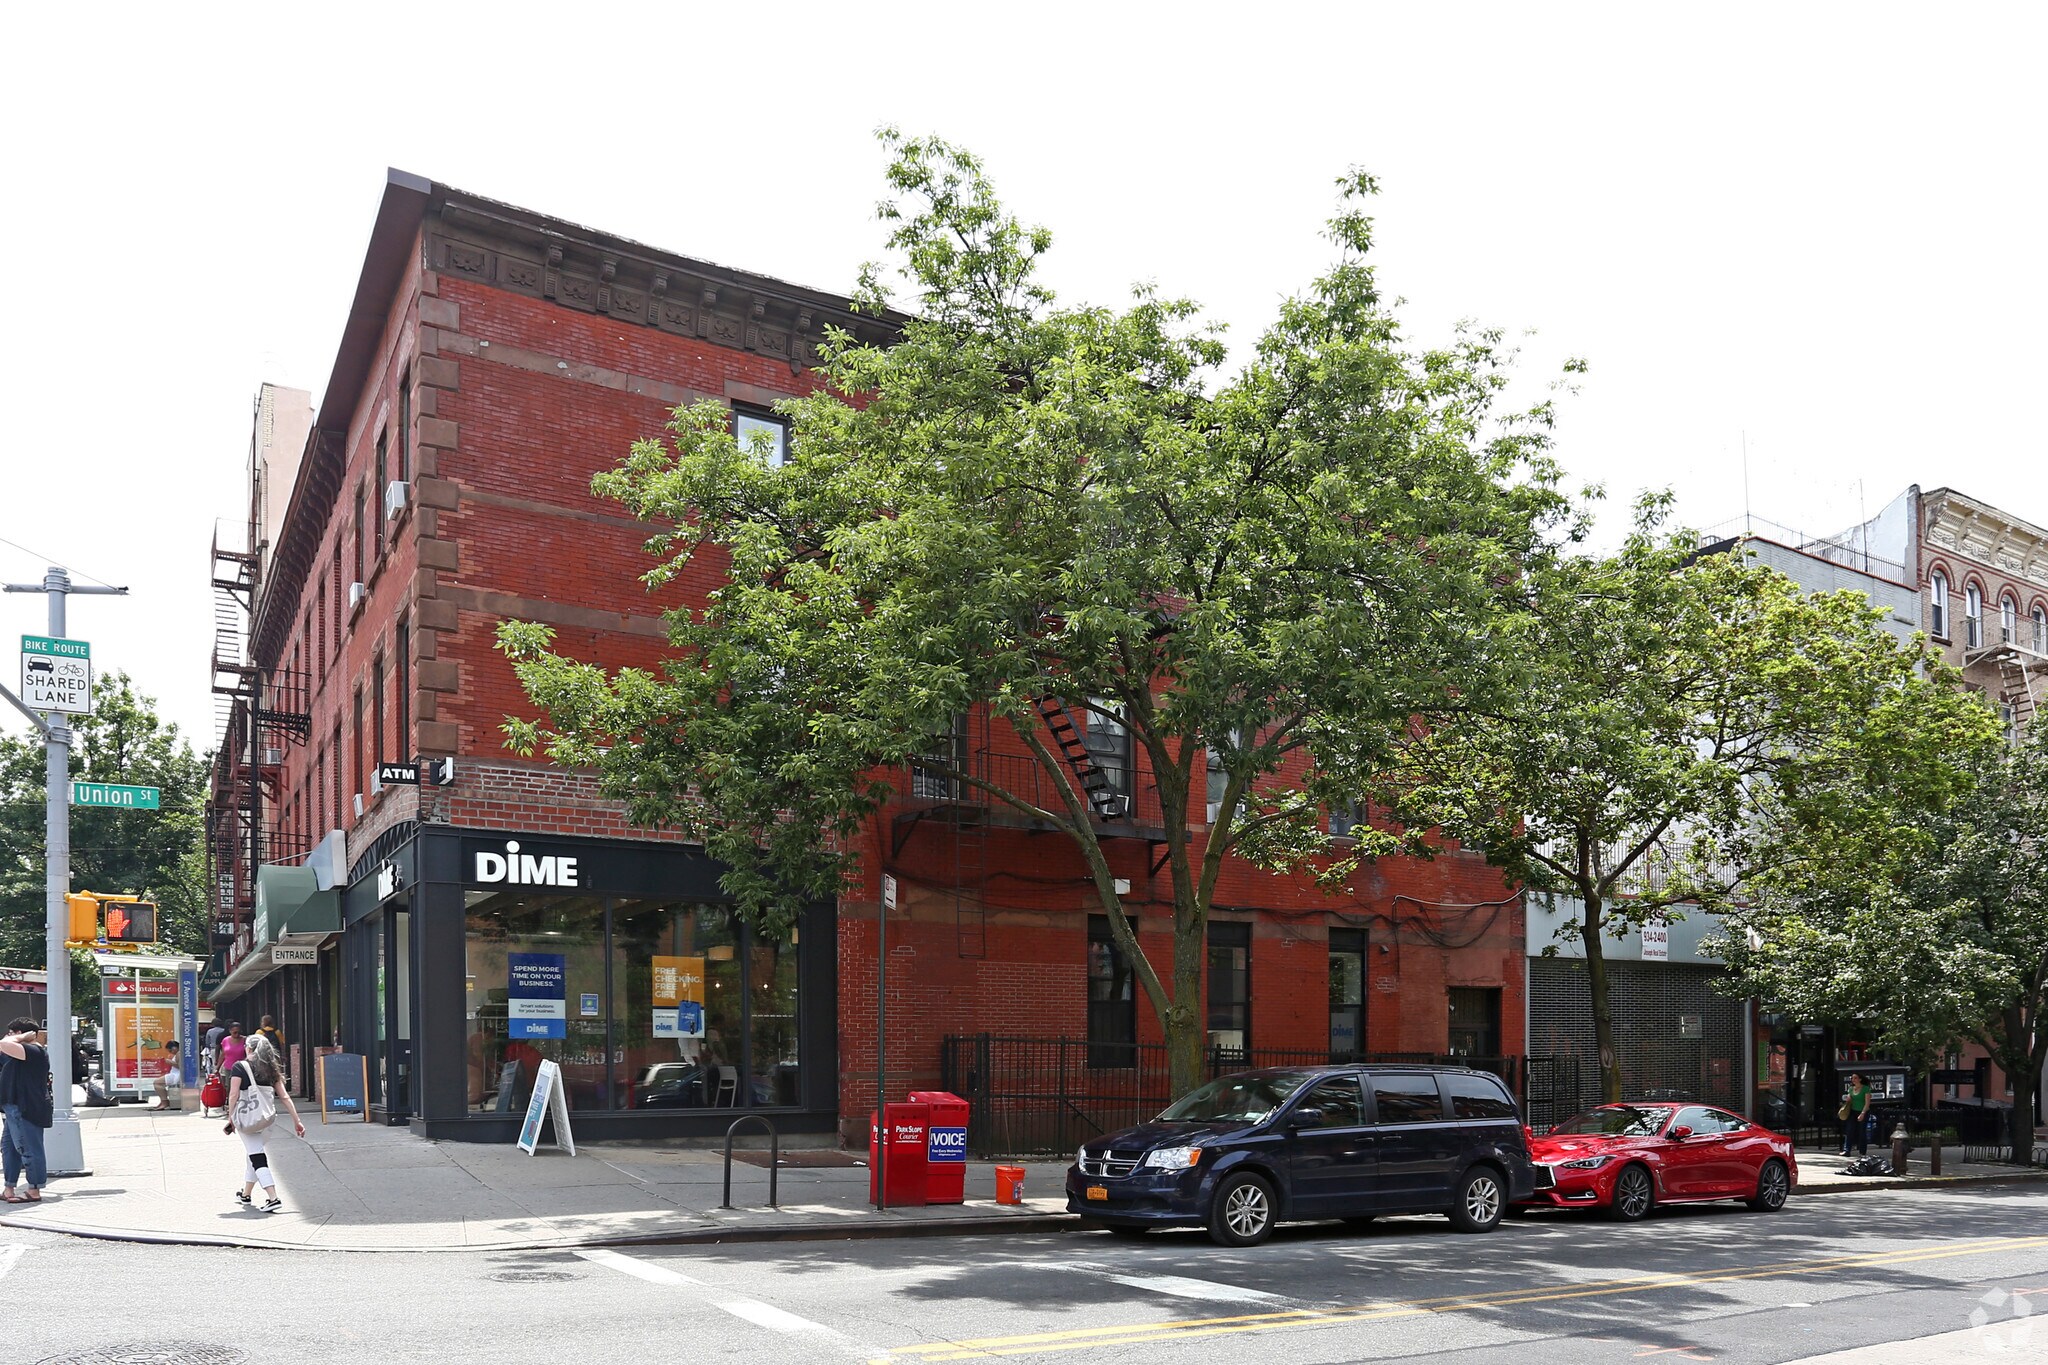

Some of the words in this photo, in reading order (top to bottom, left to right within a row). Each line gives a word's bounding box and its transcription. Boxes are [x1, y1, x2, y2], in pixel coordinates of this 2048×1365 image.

[25, 640, 48, 651] BIKE
[53, 643, 87, 656] ROUTE
[26, 674, 86, 691] SHARED
[35, 690, 77, 704] LANE
[381, 767, 415, 780] ATM
[79, 785, 133, 805] Union
[140, 789, 152, 800] St
[1643, 931, 1667, 943] 934-2400
[275, 950, 315, 960] ENTRANCE
[654, 967, 678, 975] FREE
[654, 982, 678, 991] FREE
[183, 986, 191, 1011] Avenue
[184, 1018, 192, 1037] Union
[184, 1038, 192, 1058] Street
[898, 1132, 919, 1140] Courier
[933, 1132, 965, 1146] VOICE
